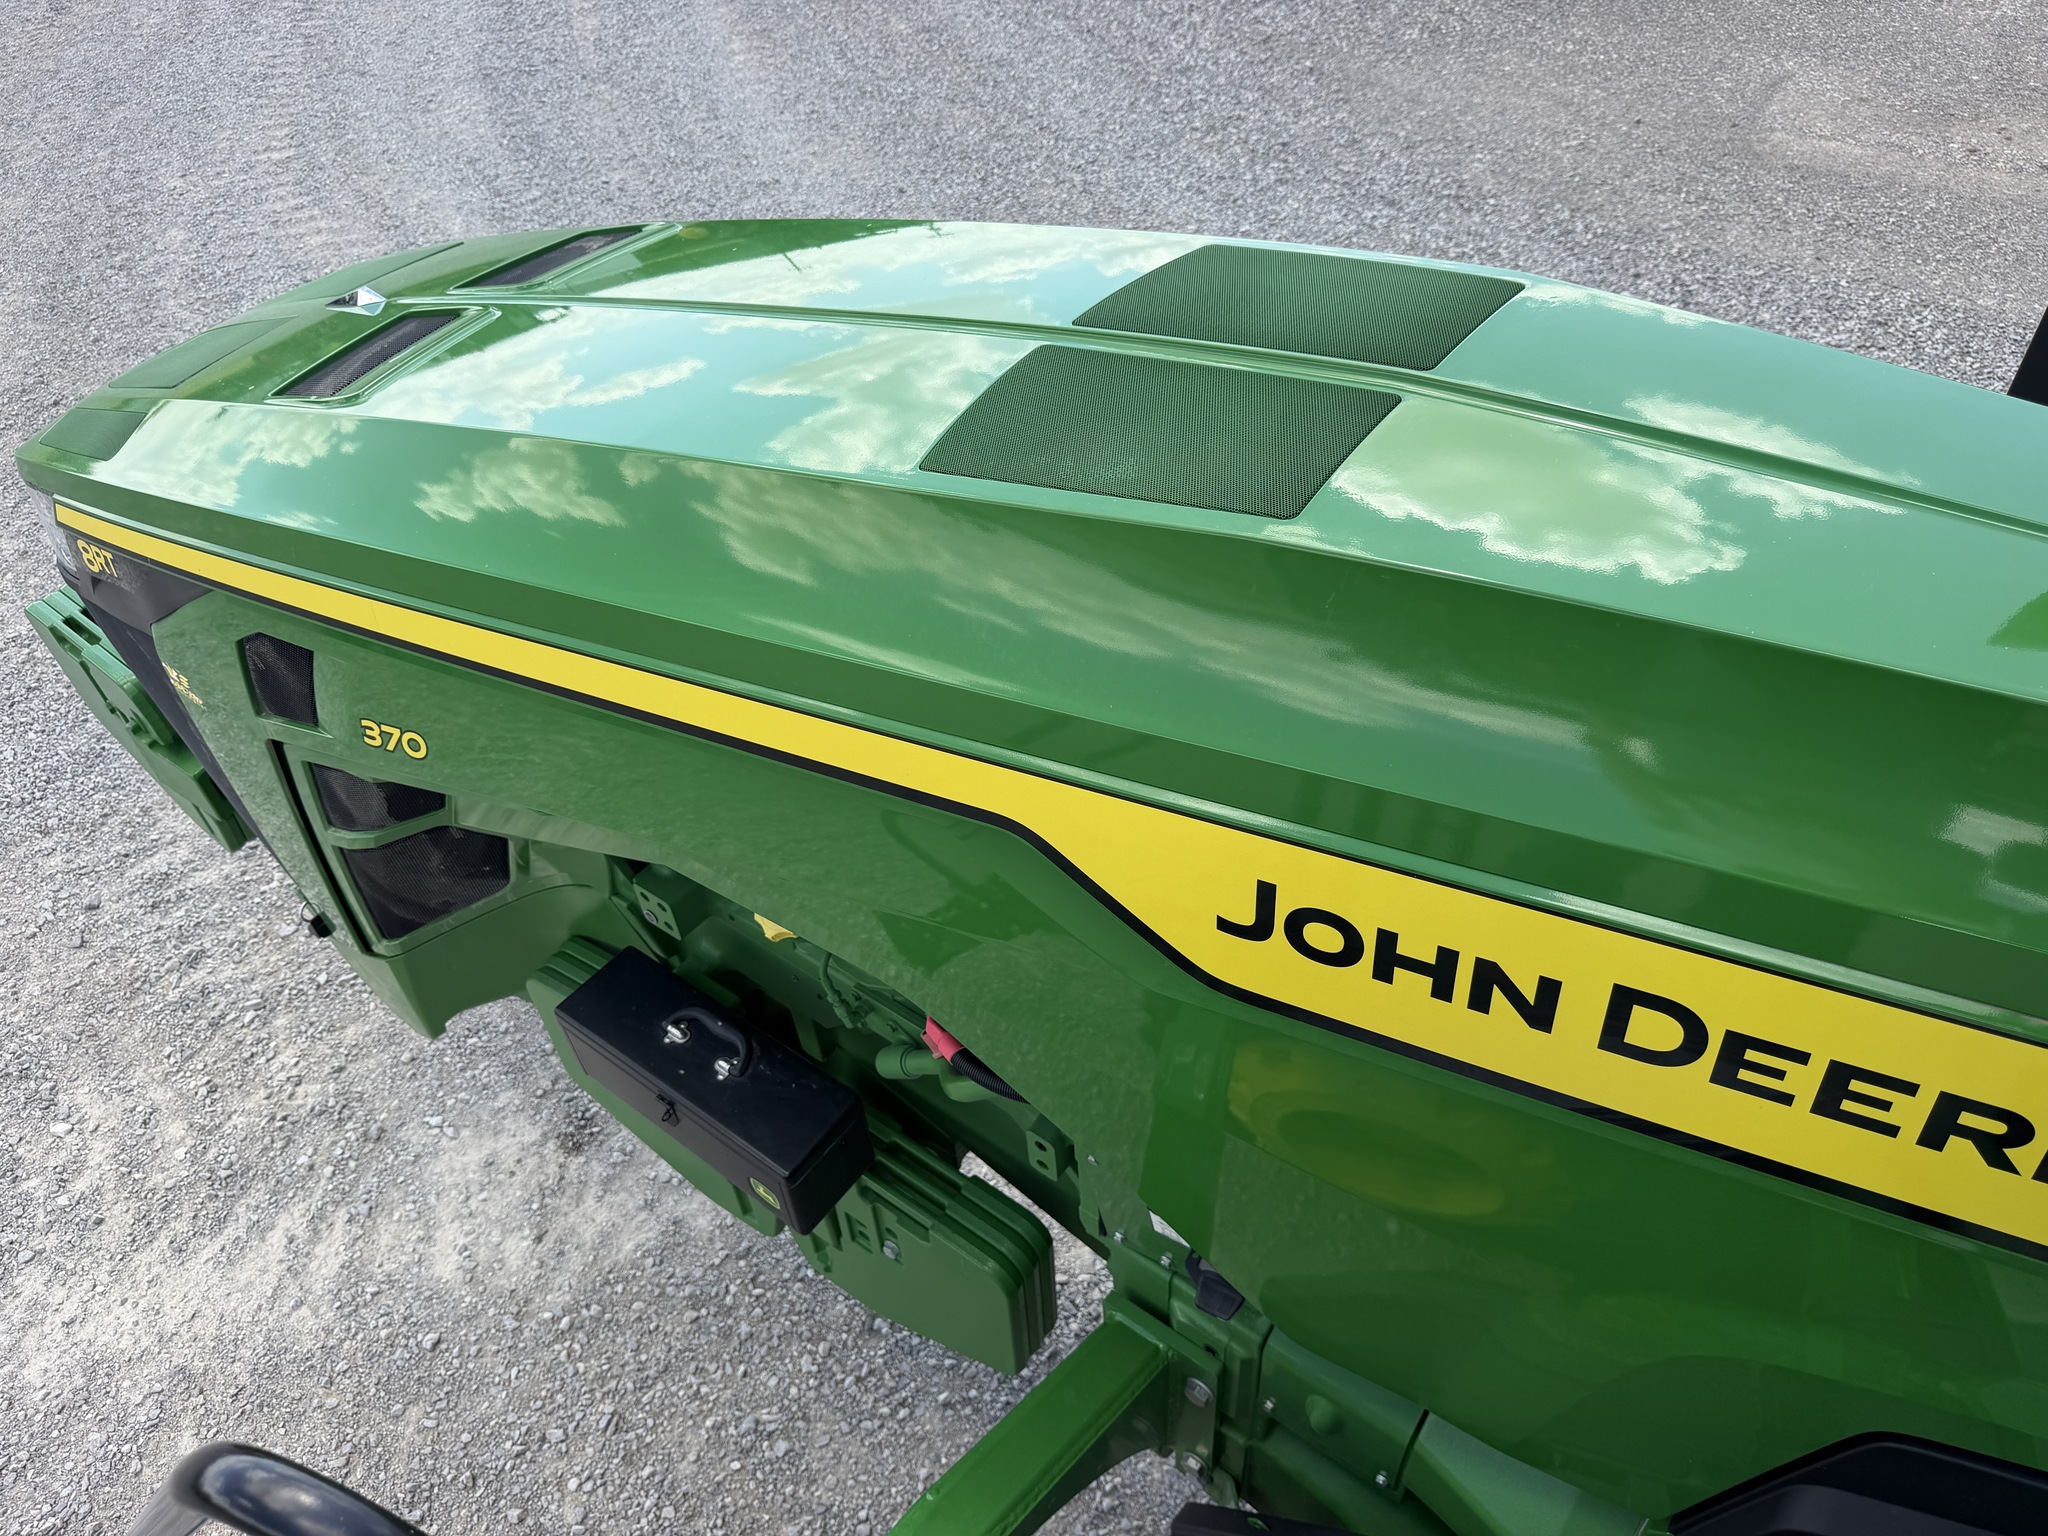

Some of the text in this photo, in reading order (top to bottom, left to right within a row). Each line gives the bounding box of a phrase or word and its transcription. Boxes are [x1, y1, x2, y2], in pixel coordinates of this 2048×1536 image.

[77, 539, 118, 578] 8RT
[360, 718, 428, 760] 370
[1216, 879, 2048, 1185] JOHN DEER
